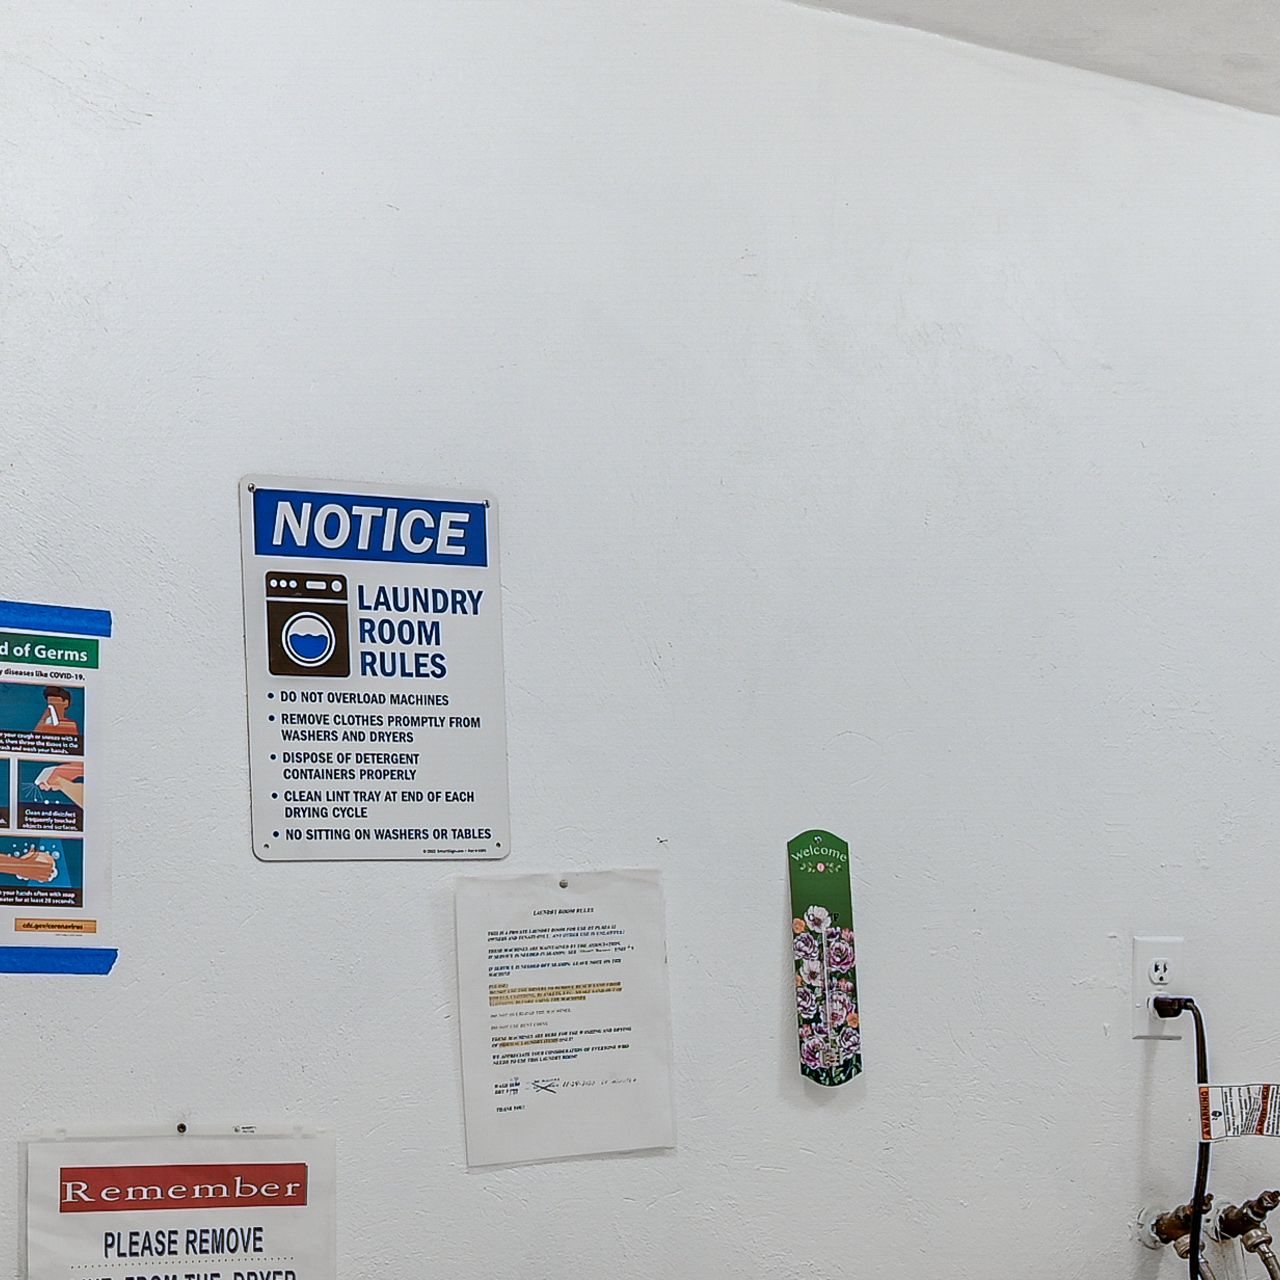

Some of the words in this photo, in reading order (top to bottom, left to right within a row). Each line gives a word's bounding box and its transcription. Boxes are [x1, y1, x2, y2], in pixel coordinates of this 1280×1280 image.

[272, 501, 469, 555] NOTICE
[357, 585, 483, 615] LAUNDRY
[359, 618, 440, 645] ROOM
[13, 644, 30, 657] of
[34, 646, 88, 662] Germs
[360, 651, 447, 678] RULES
[4, 669, 34, 677] diseases
[280, 691, 297, 703] DO
[301, 691, 324, 703] NOT
[327, 692, 386, 704] OVERLOAD
[390, 693, 449, 706] MACHINES
[281, 714, 329, 726] REMOVE
[333, 715, 383, 726] CLOTHES
[388, 716, 446, 728] PROMPTLY
[449, 717, 480, 728] FROM
[282, 729, 338, 742] WASHERS
[342, 730, 366, 742] AND
[370, 731, 414, 743] DRYERS
[283, 752, 333, 764] DISPOSE
[337, 752, 352, 764] OF
[355, 753, 419, 765] DETERGENT
[283, 768, 355, 780] CONTAINERS
[360, 769, 416, 781] PROPERLY
[284, 790, 322, 802] CLEAN
[326, 791, 350, 802] LINT
[353, 791, 381, 802] TRAY
[384, 791, 397, 802] AT
[401, 791, 423, 802] END
[427, 791, 442, 802] OF
[445, 791, 474, 802] EACH
[285, 806, 328, 818] DRYING
[332, 806, 368, 818] CYCLE
[286, 828, 302, 840] NO
[306, 828, 349, 841] SITTING
[351, 828, 370, 840] ON
[374, 828, 429, 841] WASHERS
[433, 828, 448, 840] OR
[451, 828, 491, 840] TABLES
[791, 845, 847, 862] welcome
[1201, 1091, 1210, 1132] WARNING
[62, 1176, 303, 1202] Remember
[105, 1230, 178, 1258] PLEASE
[186, 1227, 263, 1255] REMOVE
